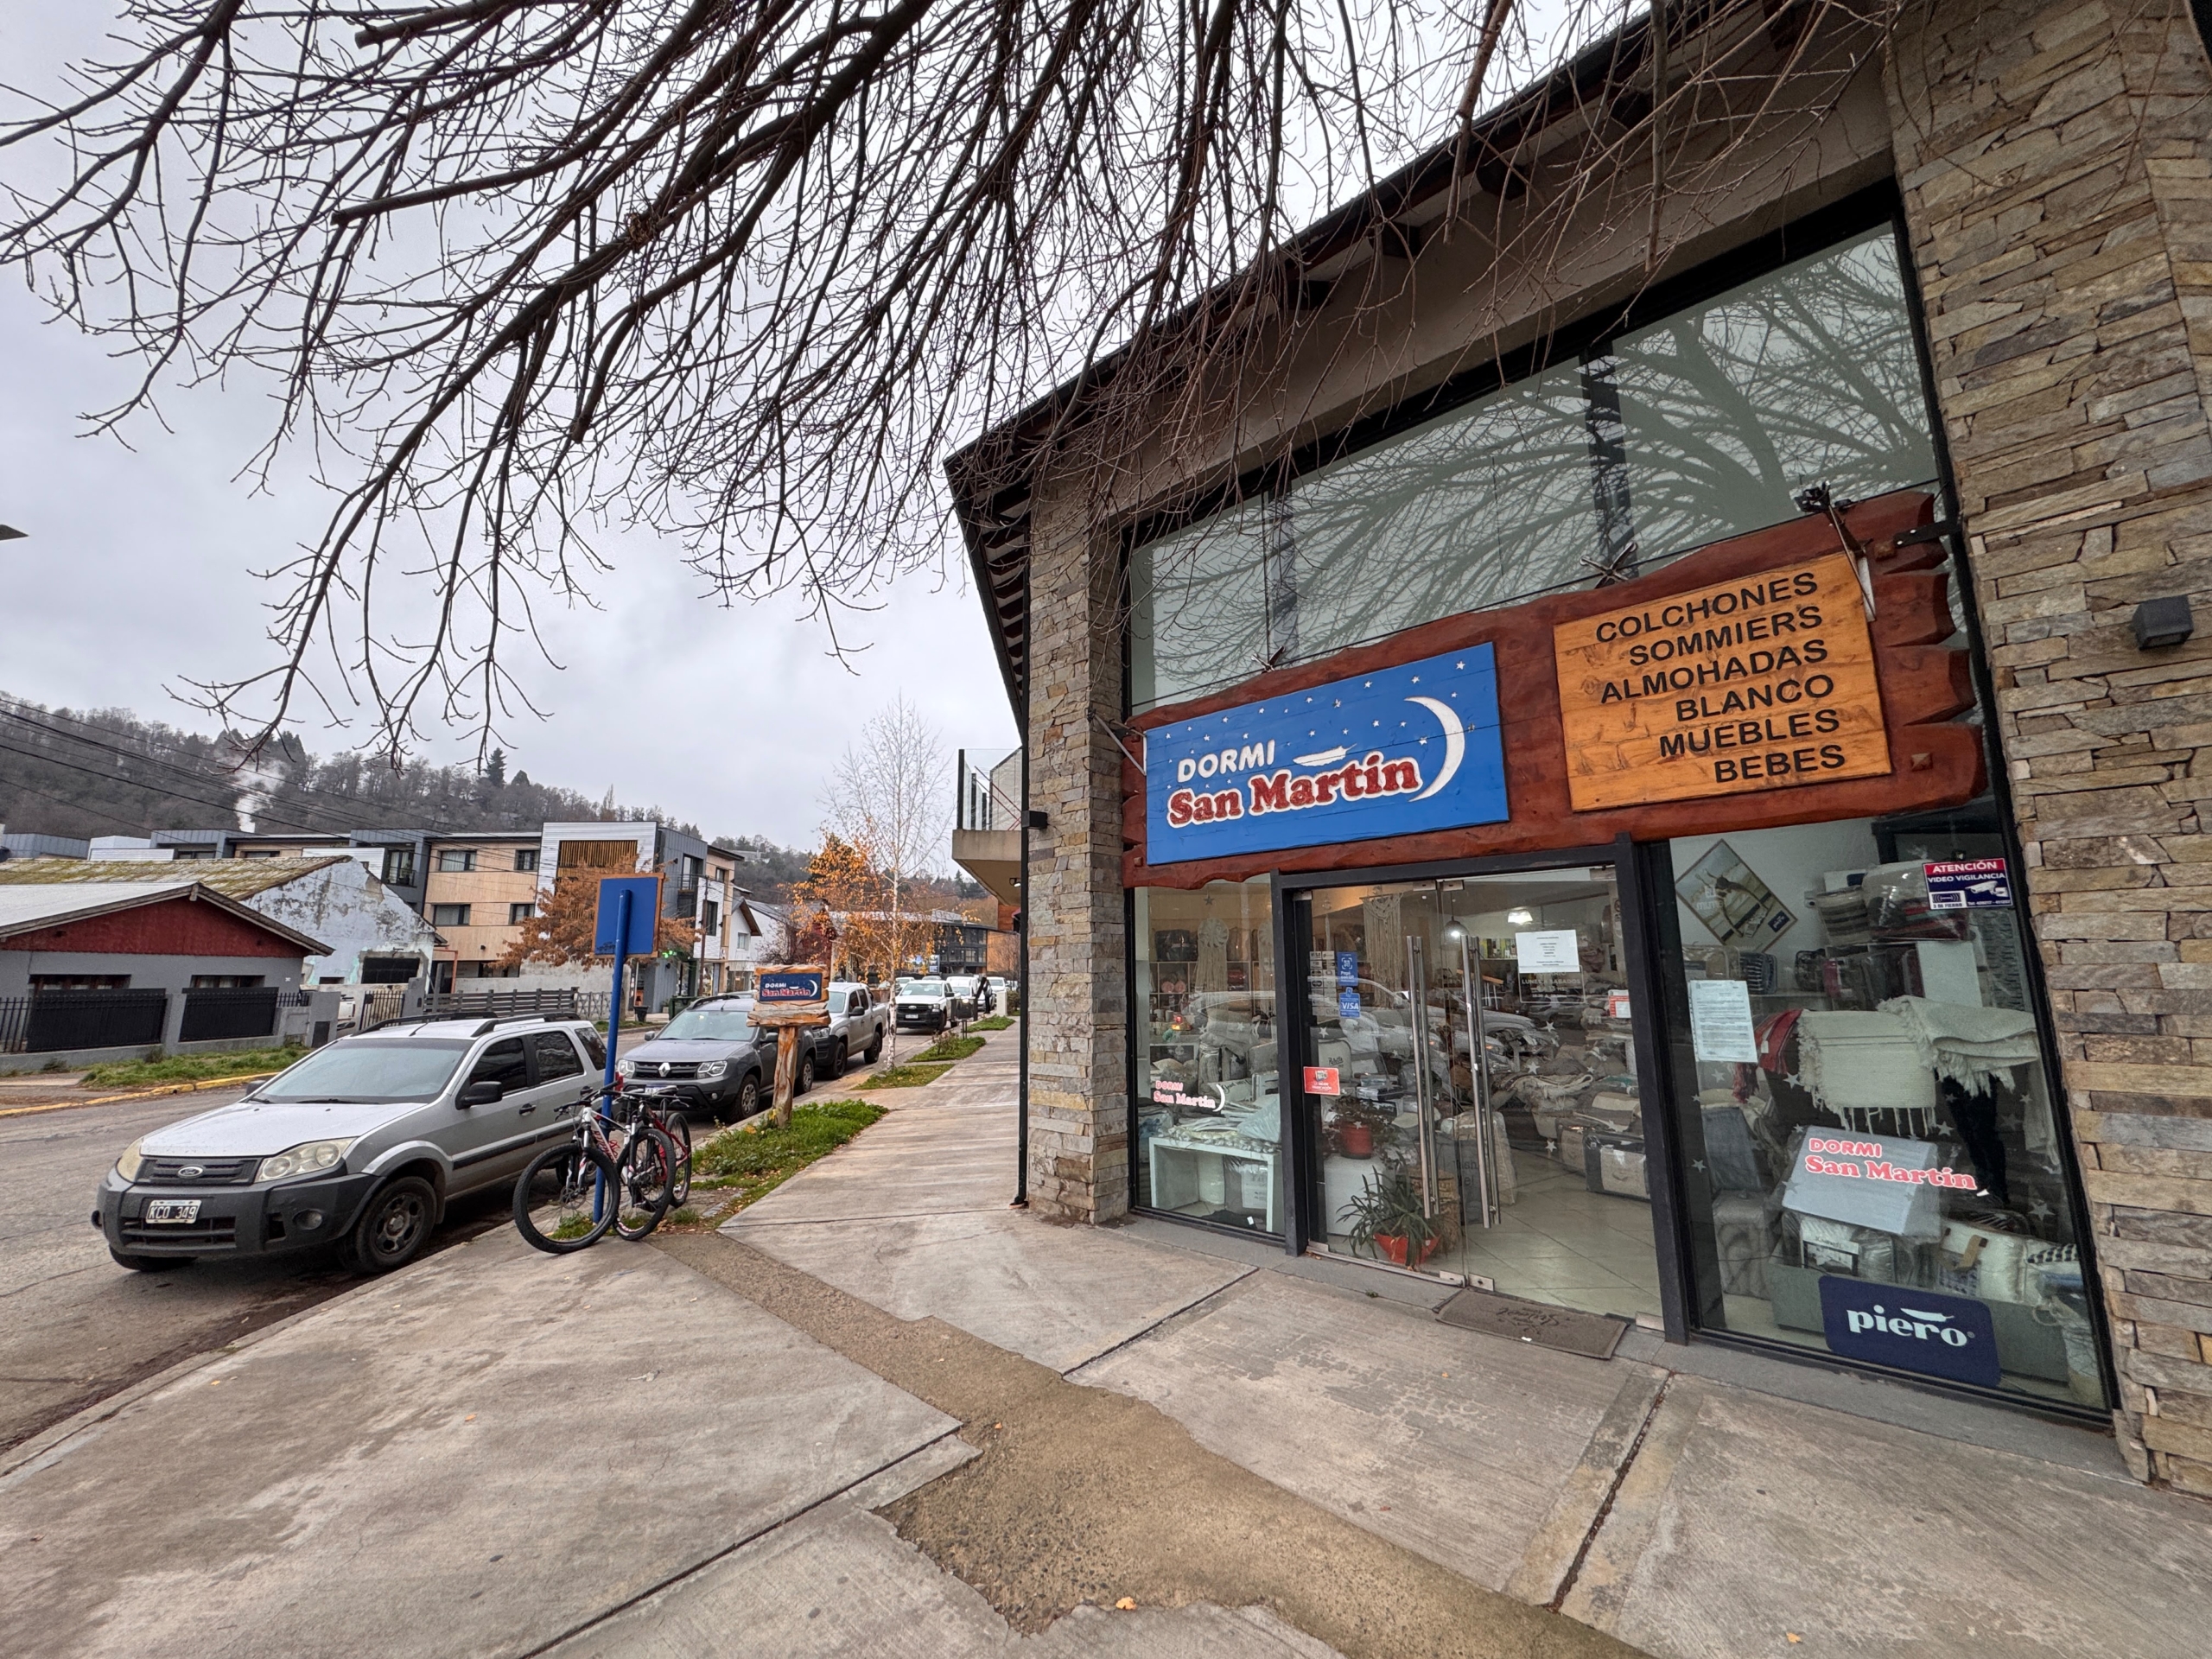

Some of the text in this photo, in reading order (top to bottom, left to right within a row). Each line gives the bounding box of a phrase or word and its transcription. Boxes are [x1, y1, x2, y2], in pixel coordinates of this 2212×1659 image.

[1596, 572, 1818, 643] COLCHONES
[1630, 606, 1822, 667] SOMMIERS
[1600, 639, 1827, 704] ALMOHADAS
[1676, 674, 1834, 721] BLANCO
[1660, 709, 1840, 758] MUEBLES
[1178, 739, 1275, 783] DORMI
[1714, 744, 1846, 783] BEBES
[1167, 788, 1244, 829] San
[1932, 860, 1997, 873] ATENCIÓN
[1955, 873, 2005, 881] VIGILANCIA
[1154, 1090, 1174, 1104] San
[1155, 1080, 1183, 1091] DORMI
[1805, 1154, 1860, 1178] San
[1808, 1137, 1883, 1158] DORMI
[148, 1206, 197, 1219] KCO 349
[1847, 1304, 1967, 1347] piero
